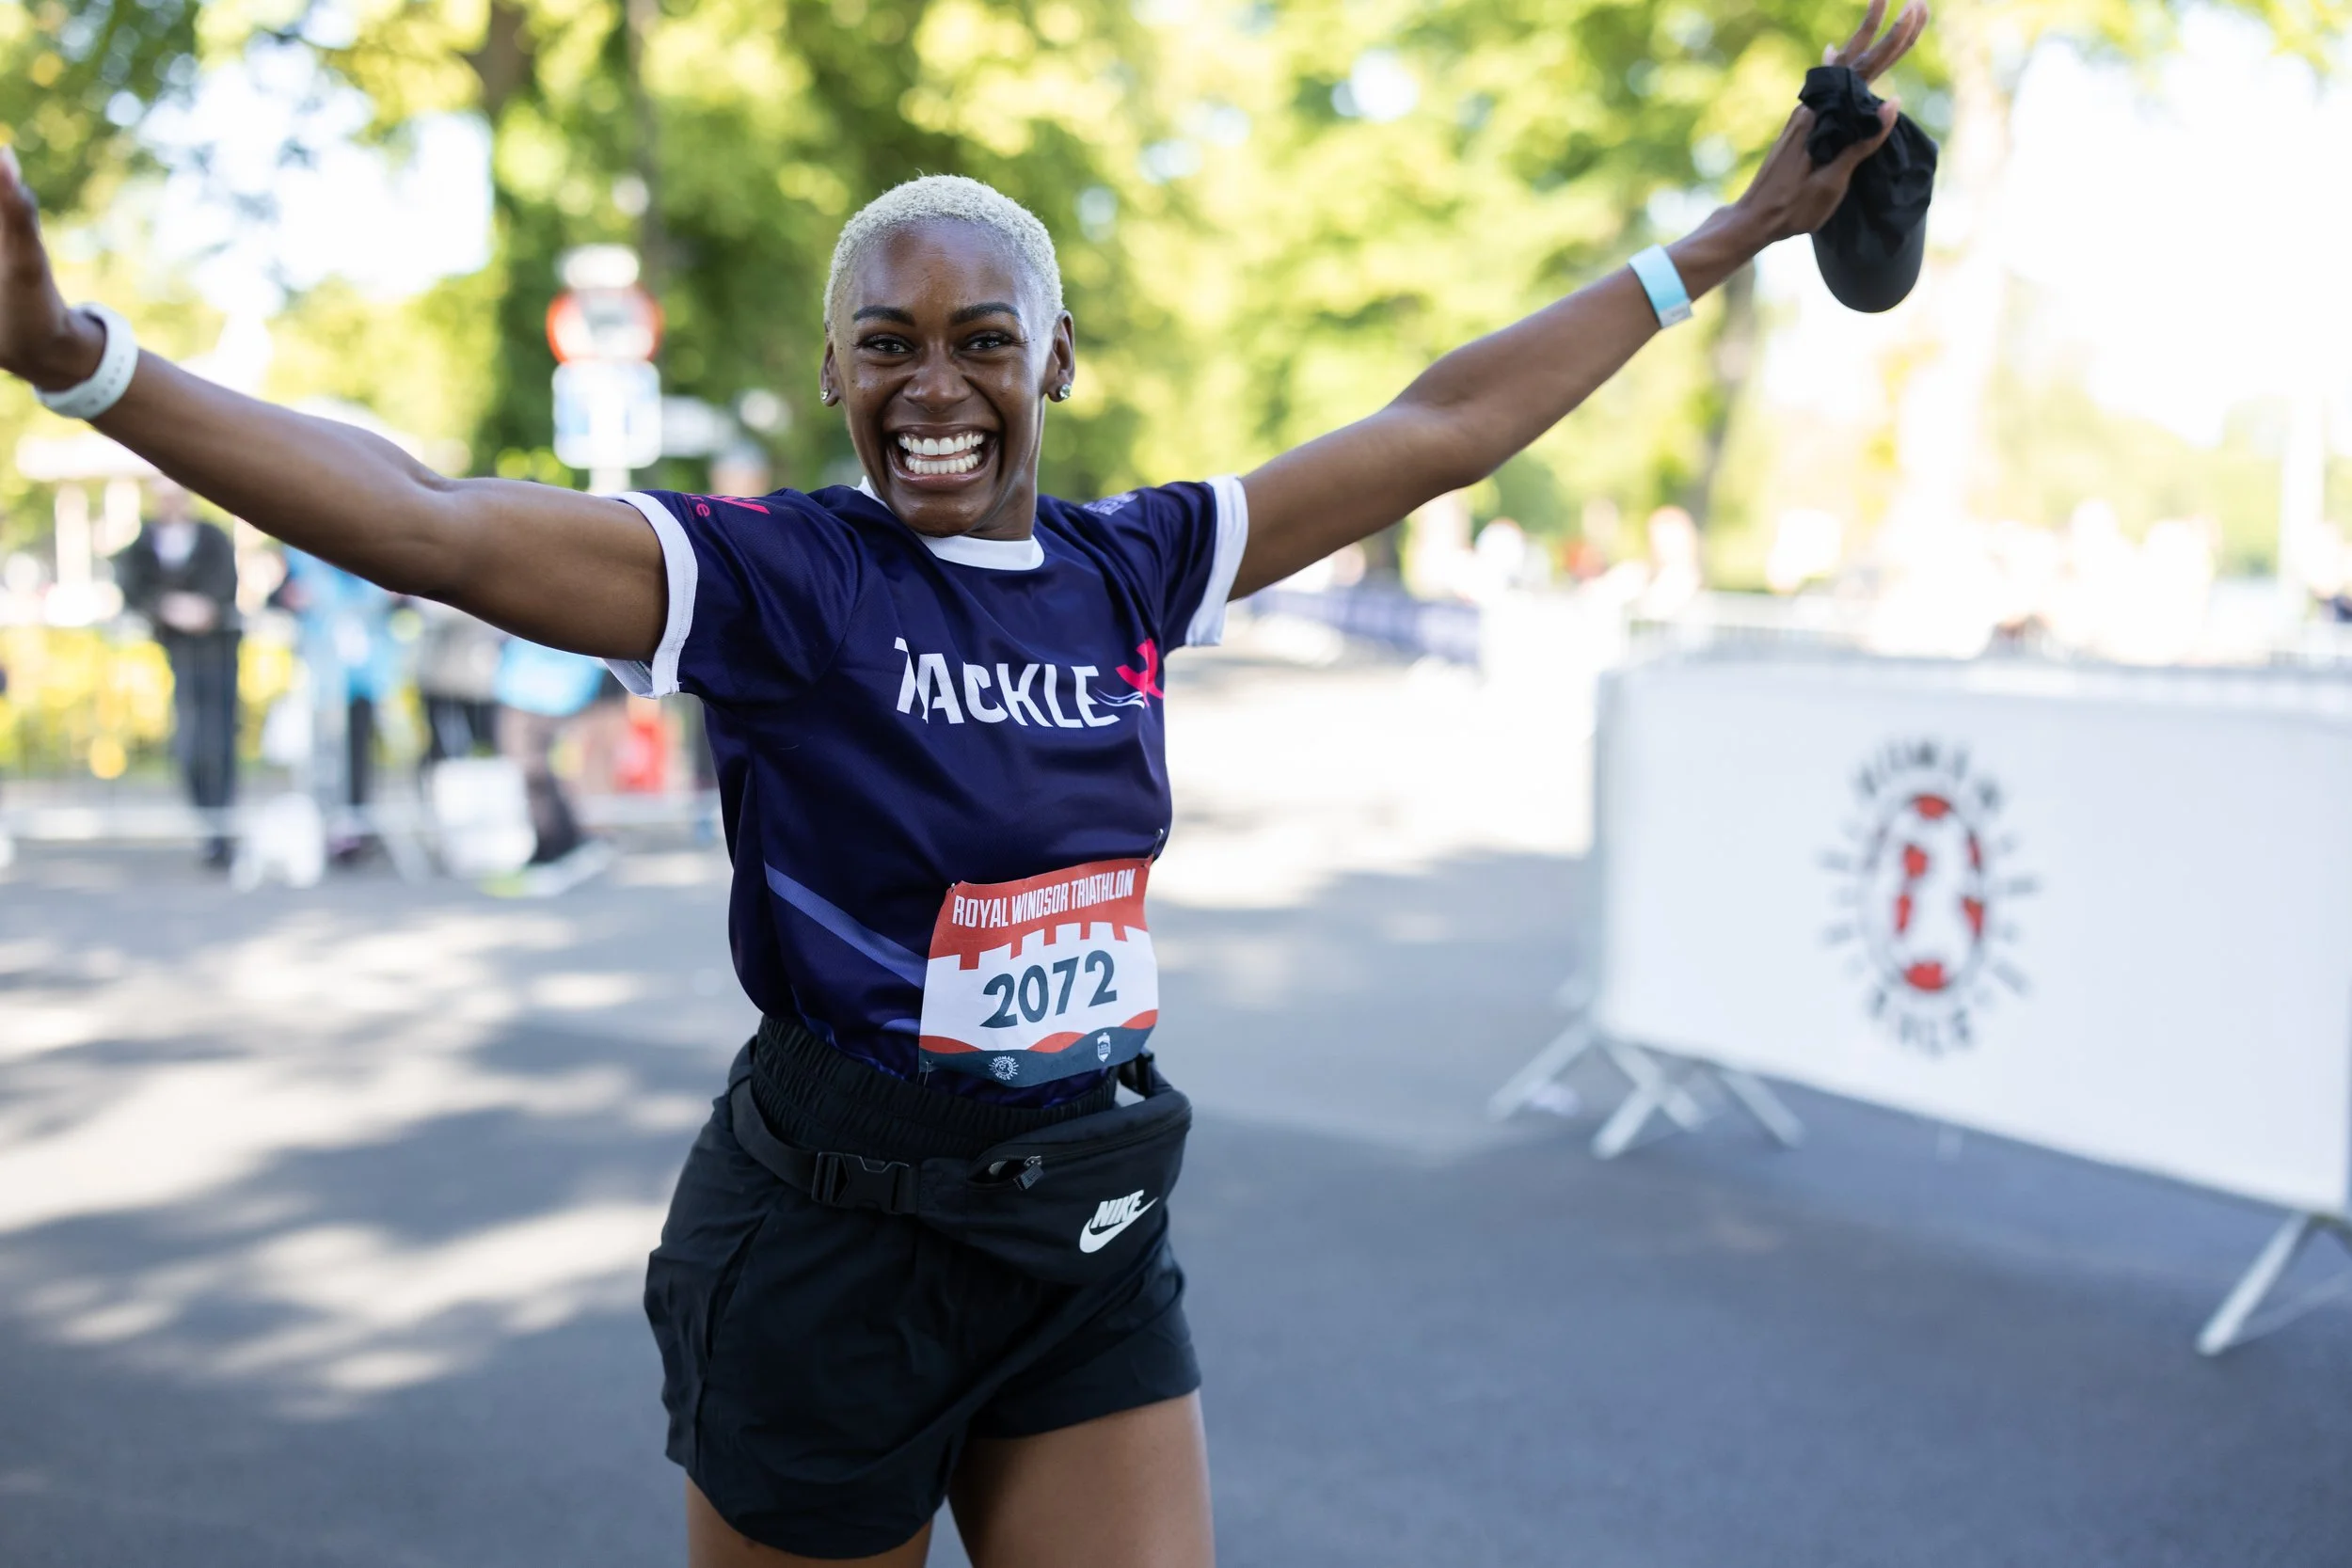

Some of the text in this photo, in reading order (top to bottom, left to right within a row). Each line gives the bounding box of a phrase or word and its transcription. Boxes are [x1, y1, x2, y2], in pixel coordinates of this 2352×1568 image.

[951, 868, 1136, 928] ROYAL WINDSOR TRIATHLON
[978, 949, 1118, 1029] 2072
[993, 1054, 1016, 1064] HUMAN
[1089, 1189, 1145, 1229] NIKE
